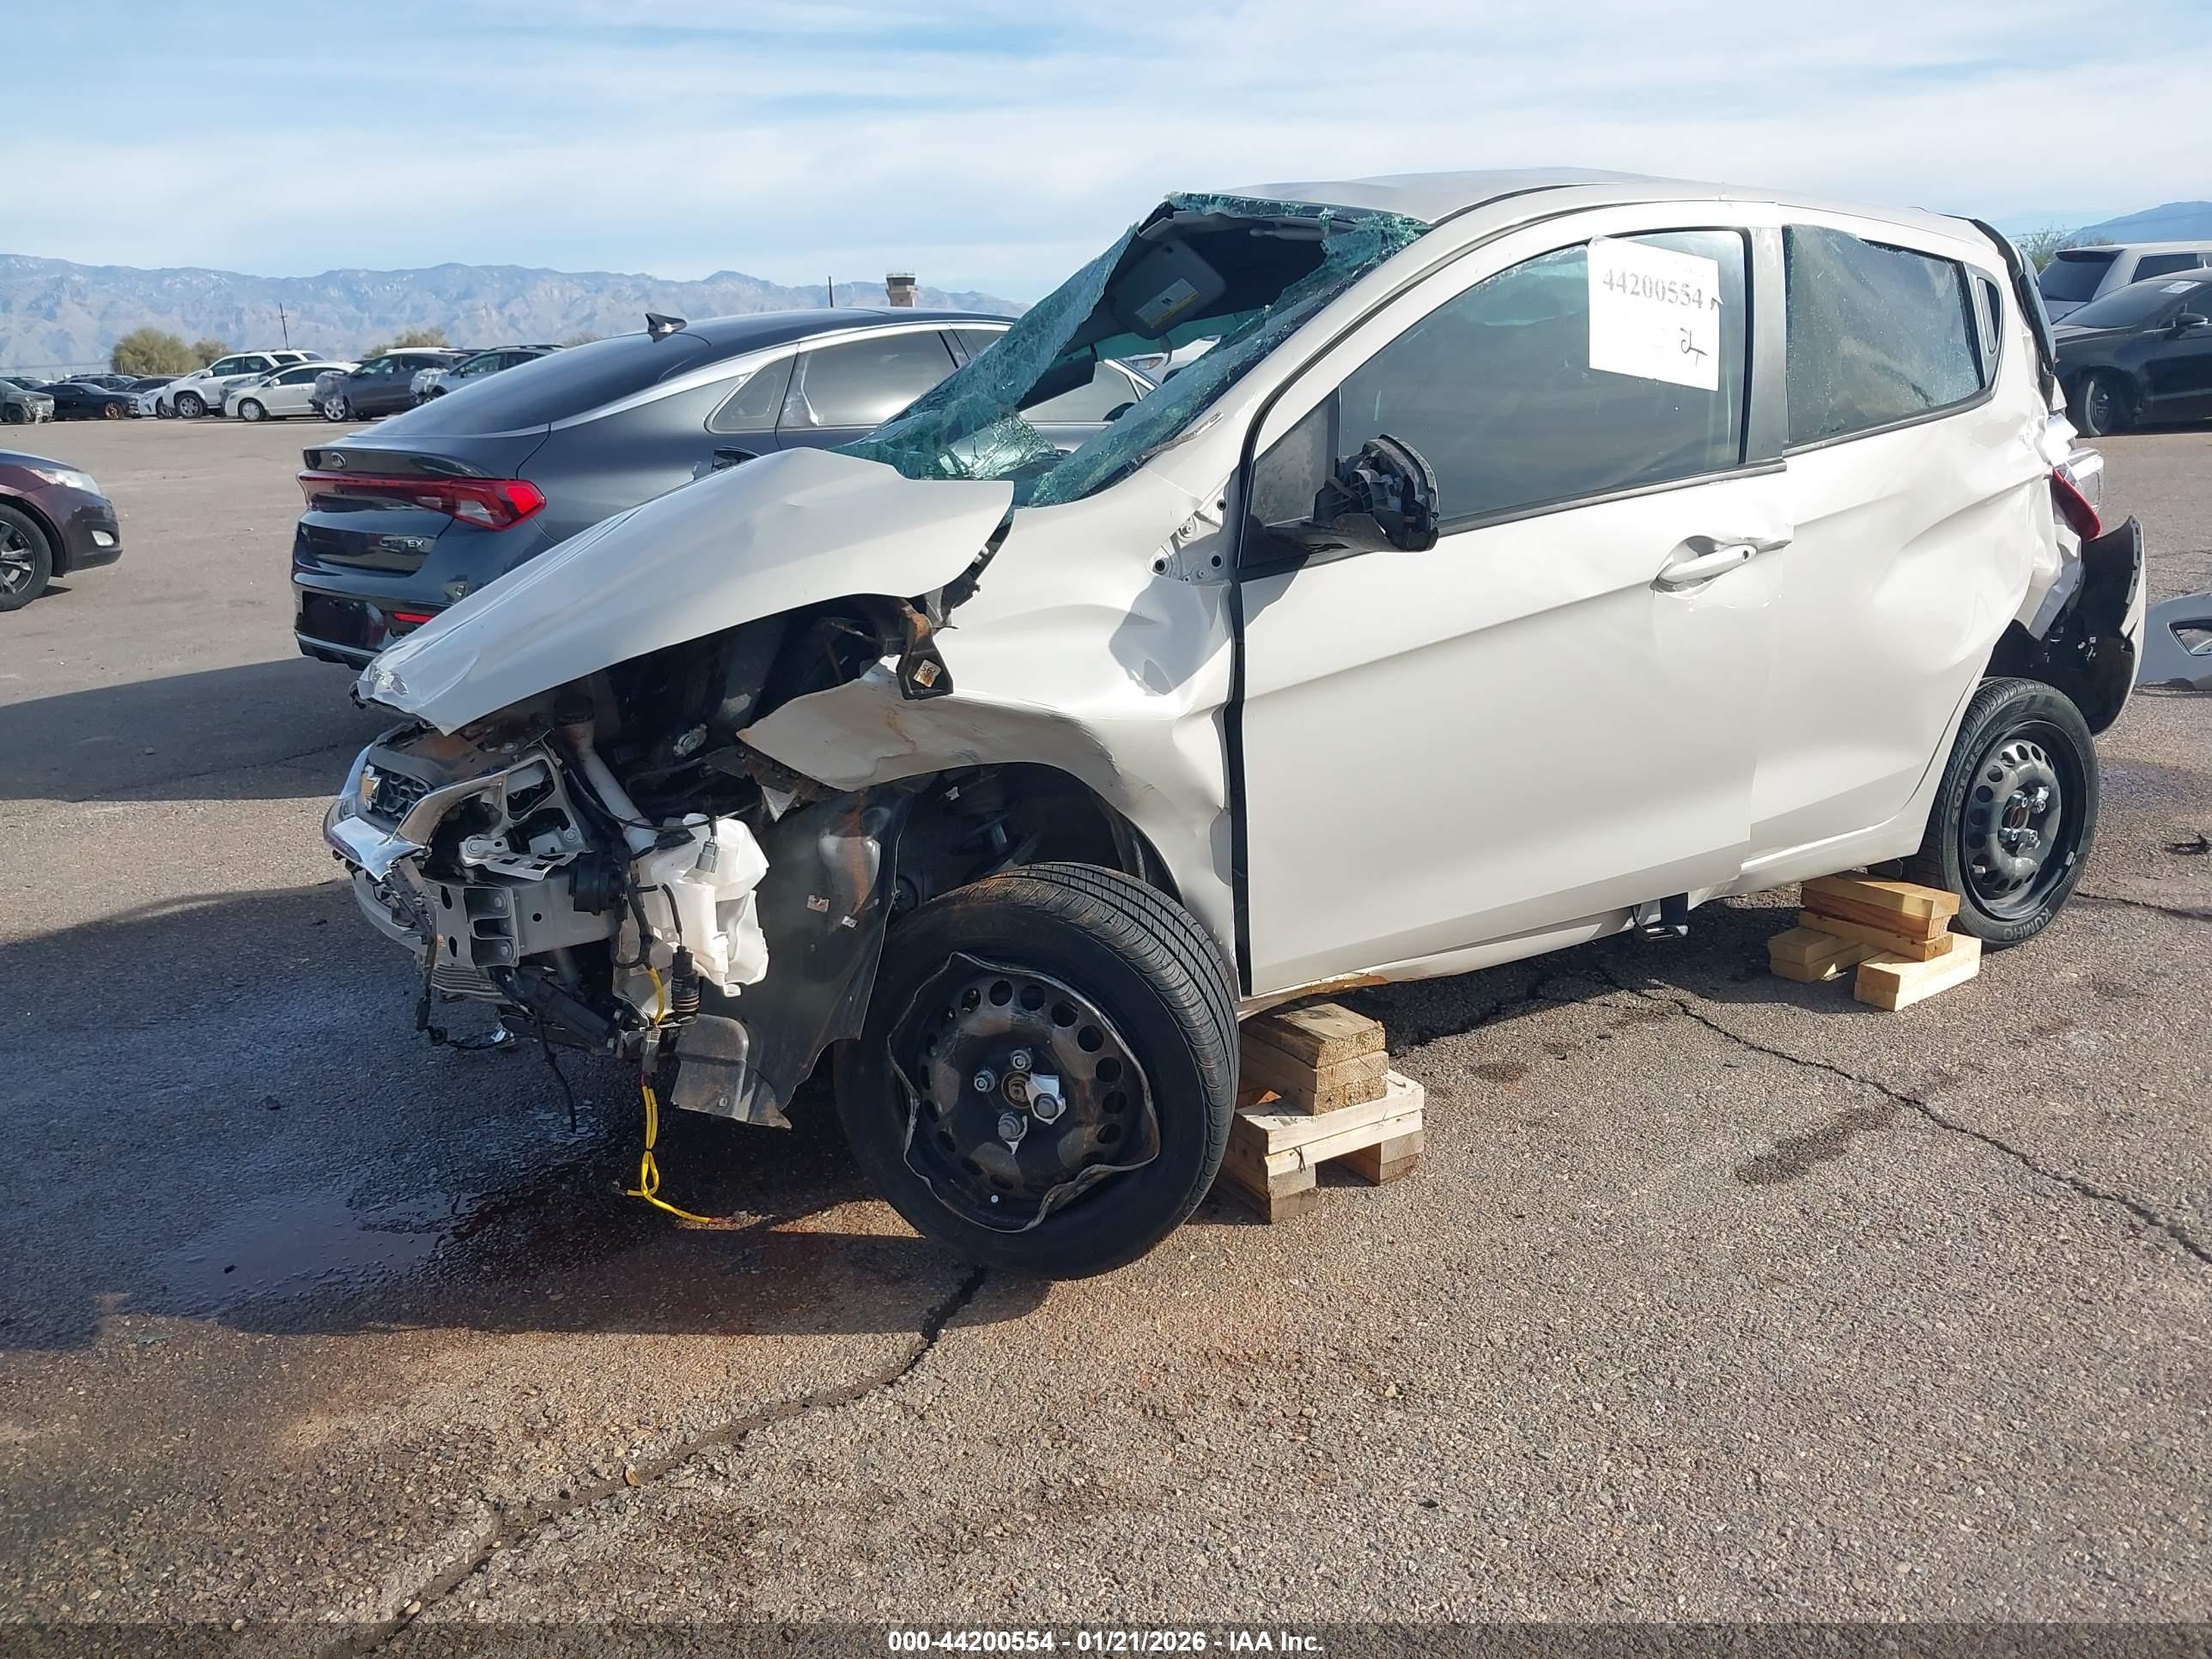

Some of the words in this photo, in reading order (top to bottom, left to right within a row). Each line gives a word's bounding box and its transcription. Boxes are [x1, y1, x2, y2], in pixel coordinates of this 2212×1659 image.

[1602, 268, 1704, 309] 44200554
[407, 539, 424, 548] EX
[2003, 907, 2053, 941] KUMHO
